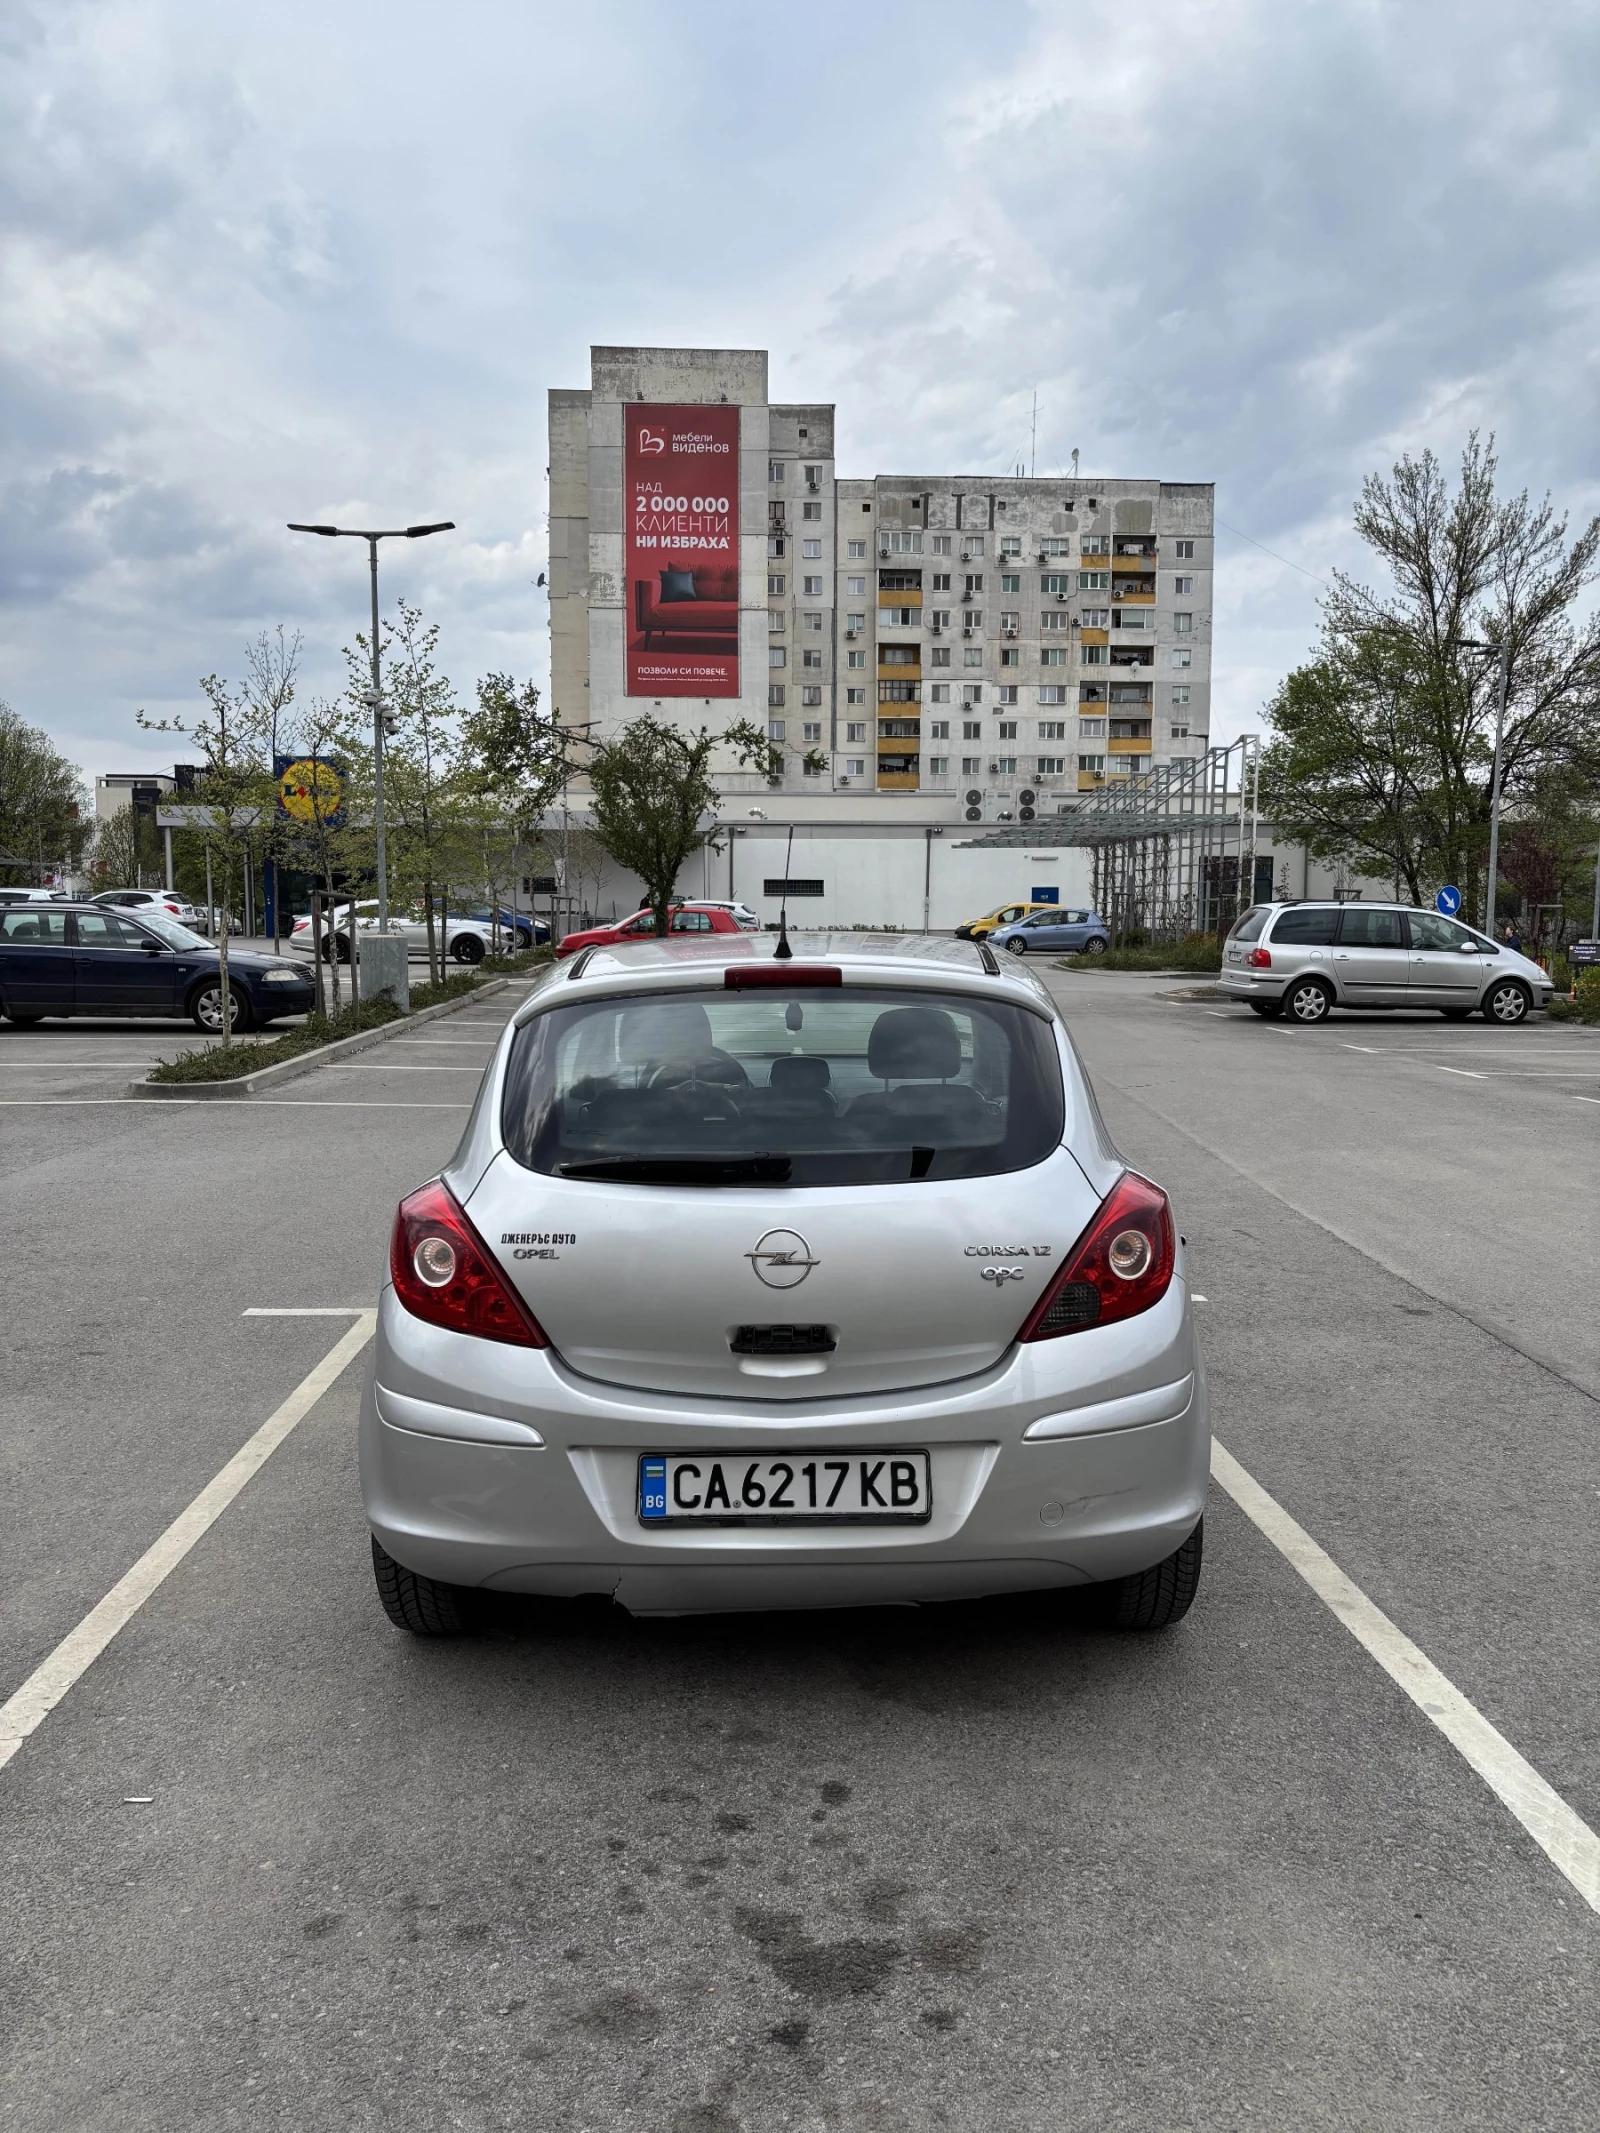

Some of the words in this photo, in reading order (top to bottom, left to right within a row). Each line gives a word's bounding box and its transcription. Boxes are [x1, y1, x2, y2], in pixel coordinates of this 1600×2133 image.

[672, 432, 713, 442] мебели
[636, 482, 663, 494] НАД
[636, 496, 647, 512] 2
[650, 496, 688, 512] 000
[691, 497, 730, 514] 000
[636, 514, 728, 532] КЛИЕНТИ
[636, 535, 657, 548] НИ
[637, 666, 678, 674] ПОЗВОЛИ
[679, 667, 692, 675] СИ
[693, 668, 728, 676] ПОВЕЧЕ.
[552, 1233, 576, 1244] АУТО
[512, 1248, 560, 1260] OPEL
[964, 1244, 1030, 1257] CORSA
[645, 1495, 664, 1508] BG
